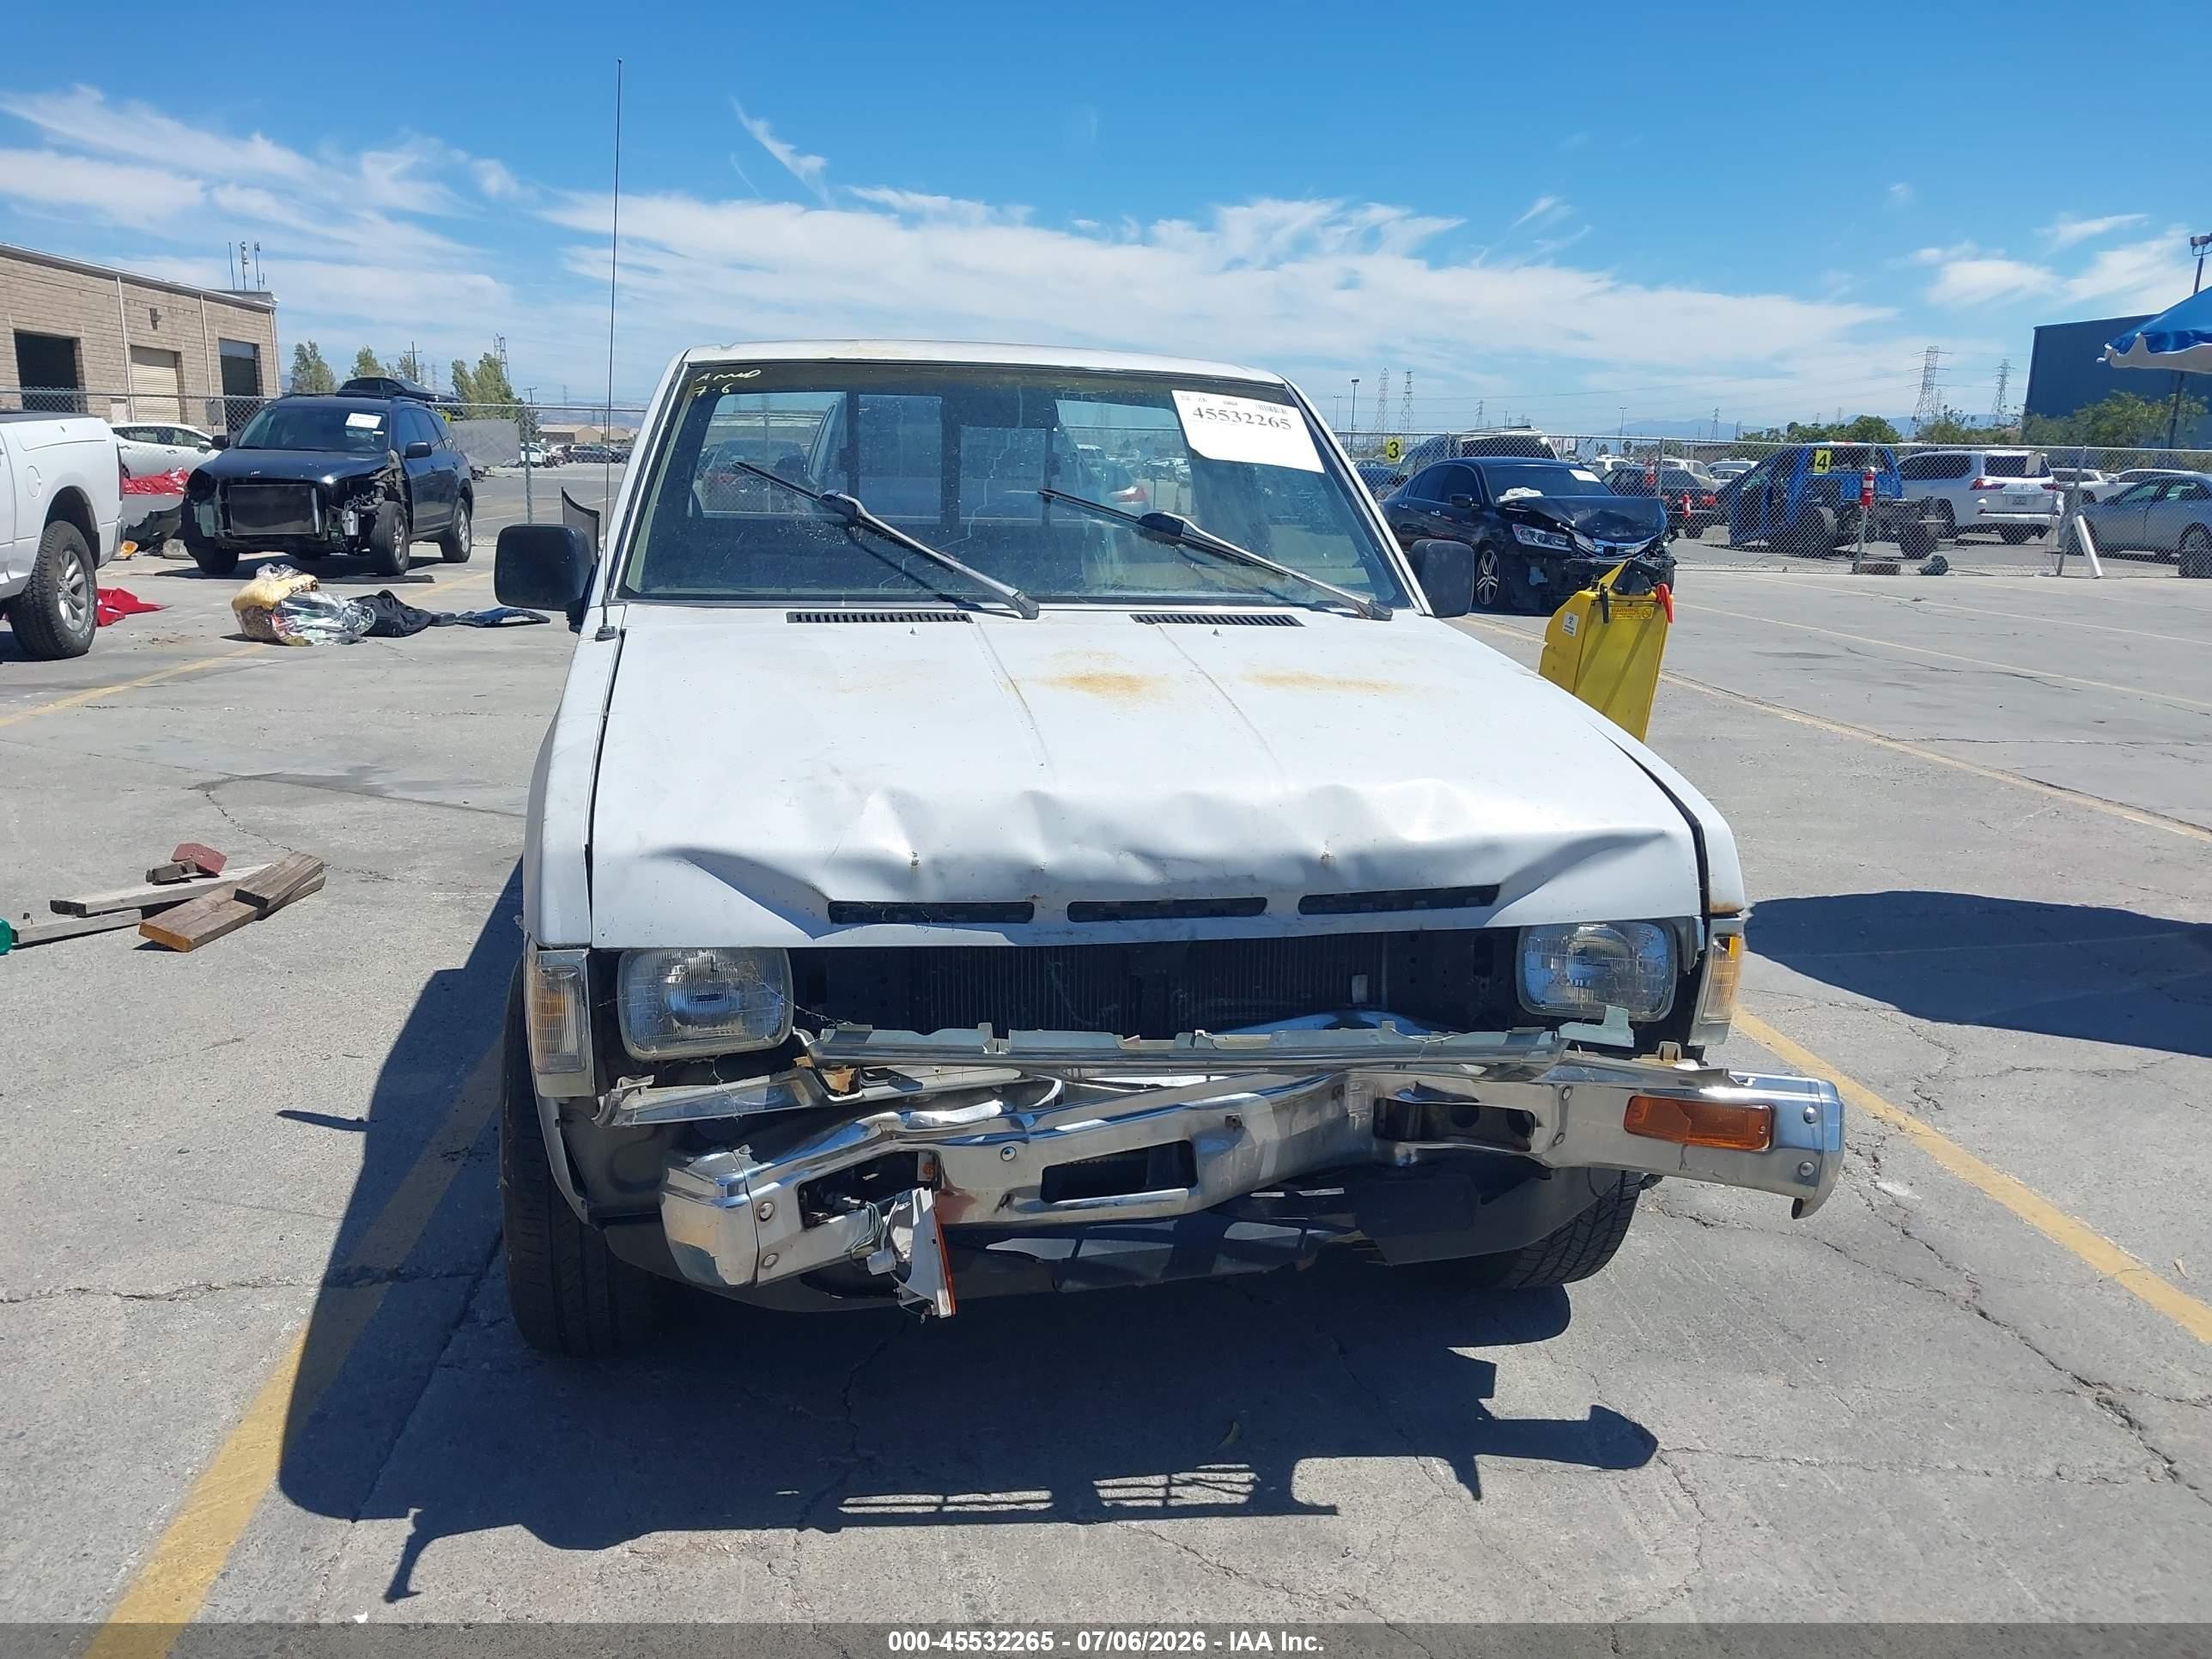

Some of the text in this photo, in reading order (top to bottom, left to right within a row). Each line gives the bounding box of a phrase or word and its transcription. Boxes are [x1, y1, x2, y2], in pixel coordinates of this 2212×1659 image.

[1193, 406, 1291, 430] 45532265
[1388, 441, 1399, 459] 3
[1816, 453, 1828, 470] 4
